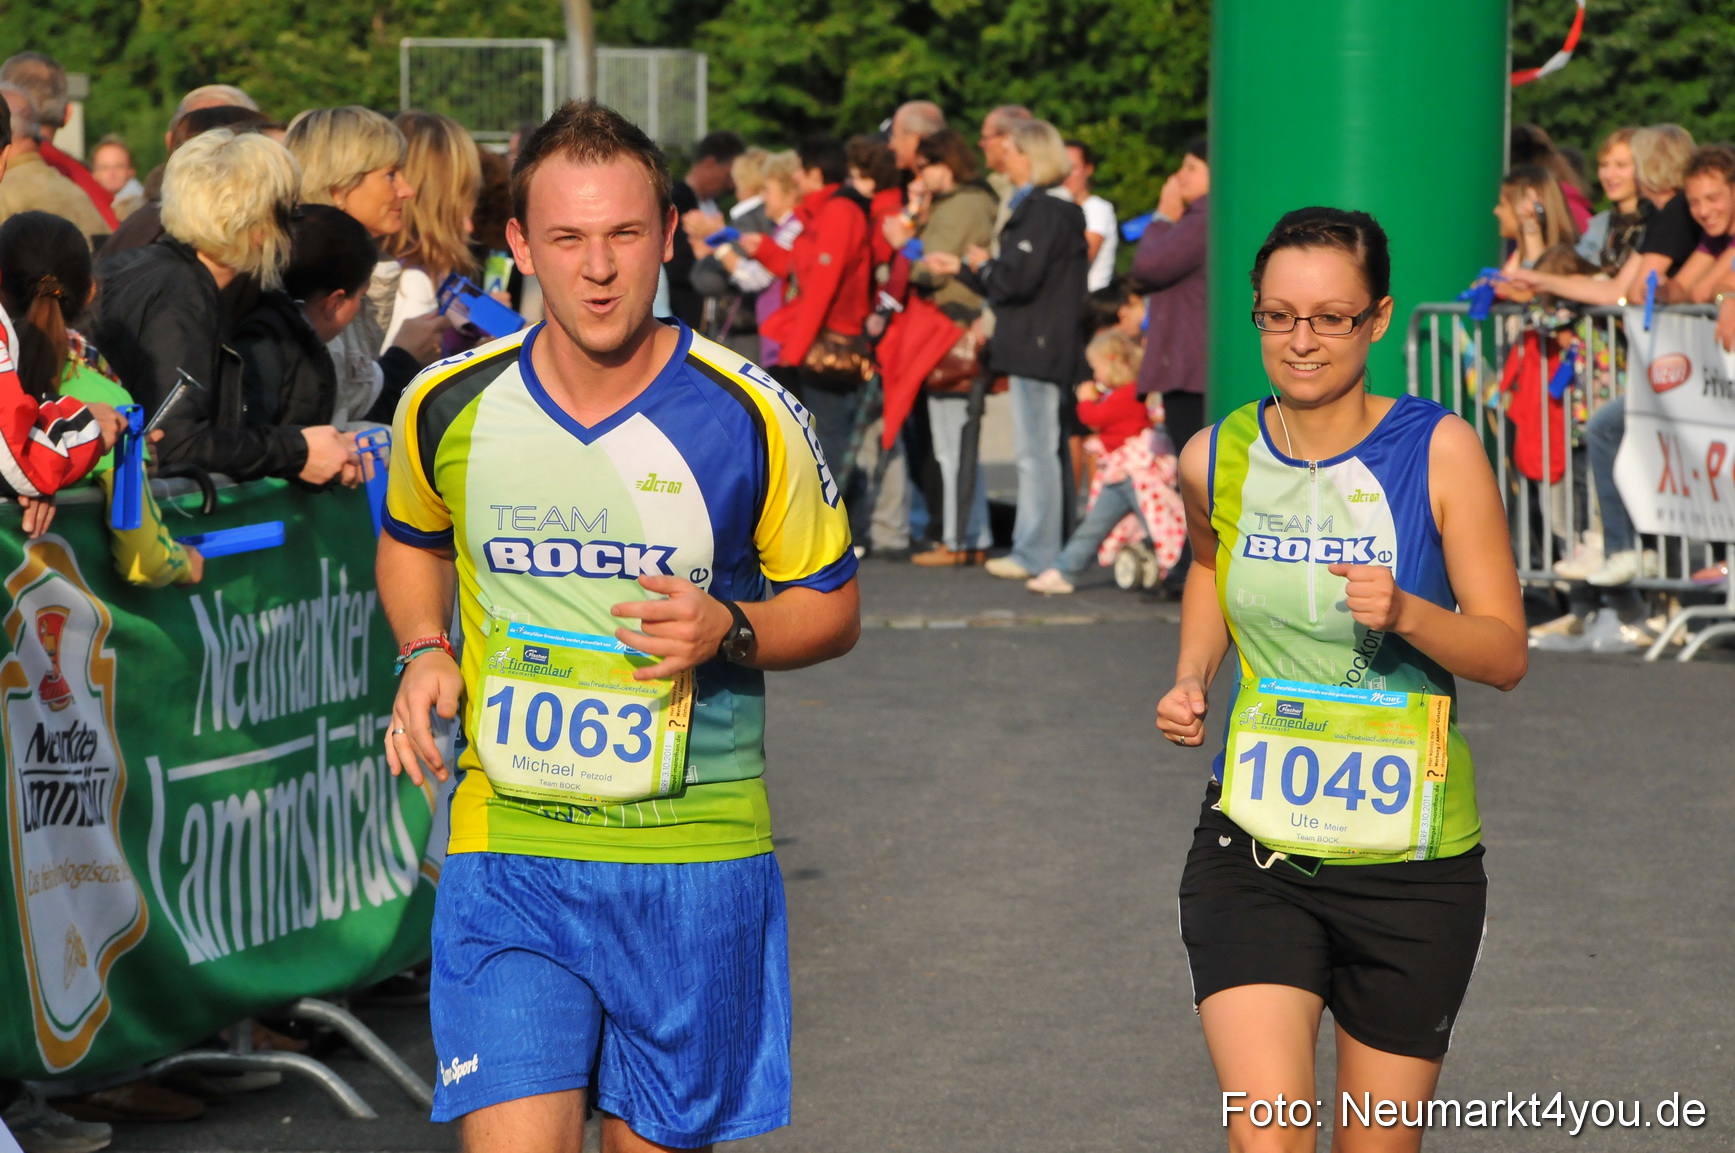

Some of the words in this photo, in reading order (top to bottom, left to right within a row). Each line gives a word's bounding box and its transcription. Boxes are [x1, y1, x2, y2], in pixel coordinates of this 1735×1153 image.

[490, 505, 608, 533] TEAM
[1255, 512, 1334, 533] TEAM
[483, 537, 678, 580] BOCK
[1243, 534, 1377, 564] BOCK
[190, 557, 376, 736] Neumarkter
[526, 649, 548, 660] Fischer
[508, 658, 573, 678] firmenlauf
[1261, 713, 1329, 732] firmenlauf
[1278, 704, 1302, 714] Fischer
[487, 685, 653, 763] 1063
[512, 755, 575, 777] Michael
[581, 771, 613, 782] Petzold
[1239, 741, 1412, 815] 1049
[539, 779, 558, 788] Team
[559, 781, 581, 790] BOCK
[1290, 813, 1319, 829] Ute
[1324, 822, 1348, 833] Meier
[1423, 795, 1431, 828] 3.10.2011
[145, 716, 419, 965] Lammsbräu
[1296, 834, 1315, 842] Team
[1317, 835, 1339, 844] BOCK
